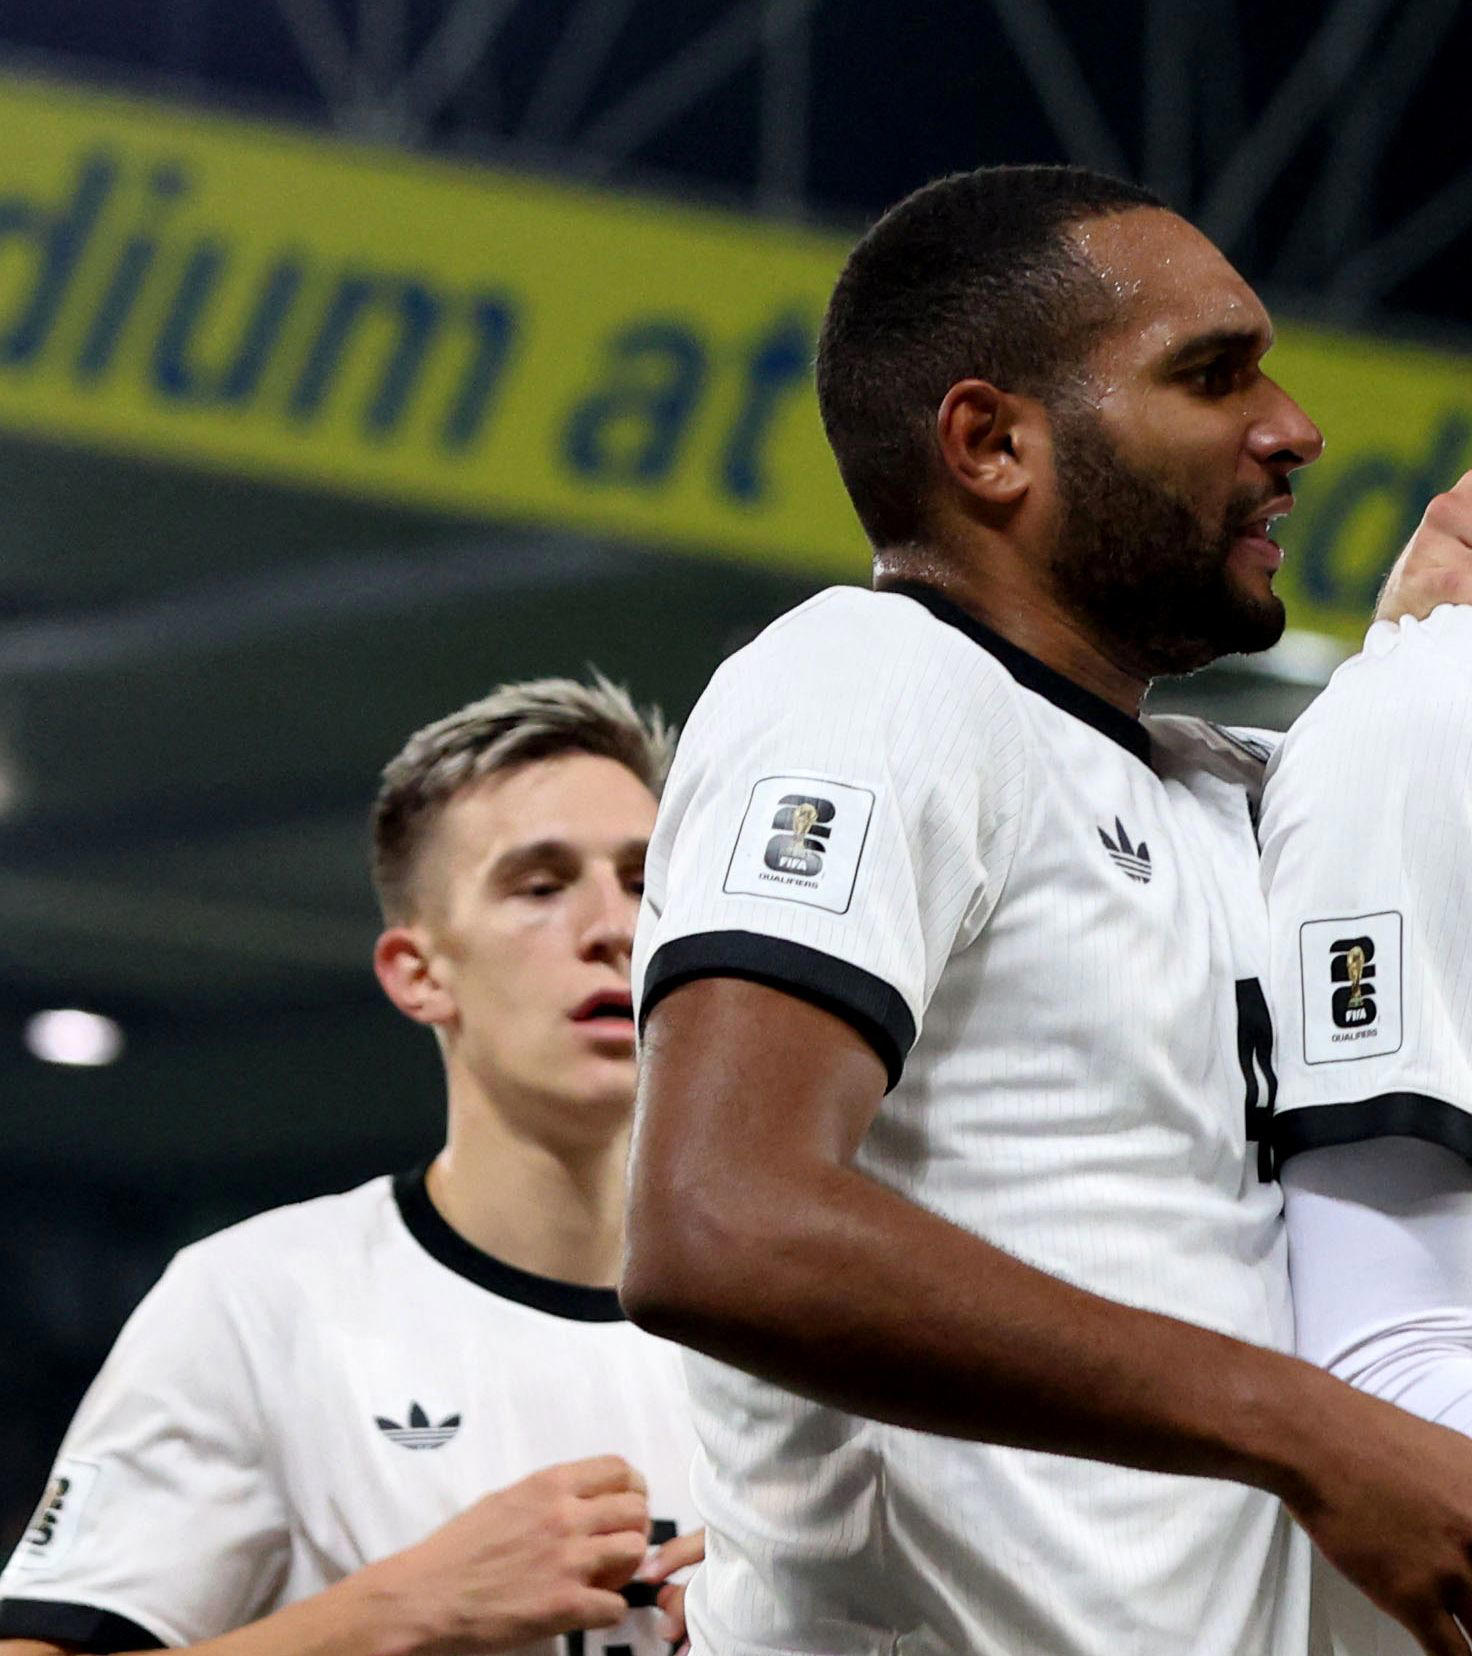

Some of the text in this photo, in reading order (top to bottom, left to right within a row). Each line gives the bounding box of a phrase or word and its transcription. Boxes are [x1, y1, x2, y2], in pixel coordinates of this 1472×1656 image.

[560, 305, 818, 512] at
[778, 855, 808, 871] FIFA
[758, 872, 818, 889] QUALIFIERS
[1345, 1007, 1367, 1022] FIFA
